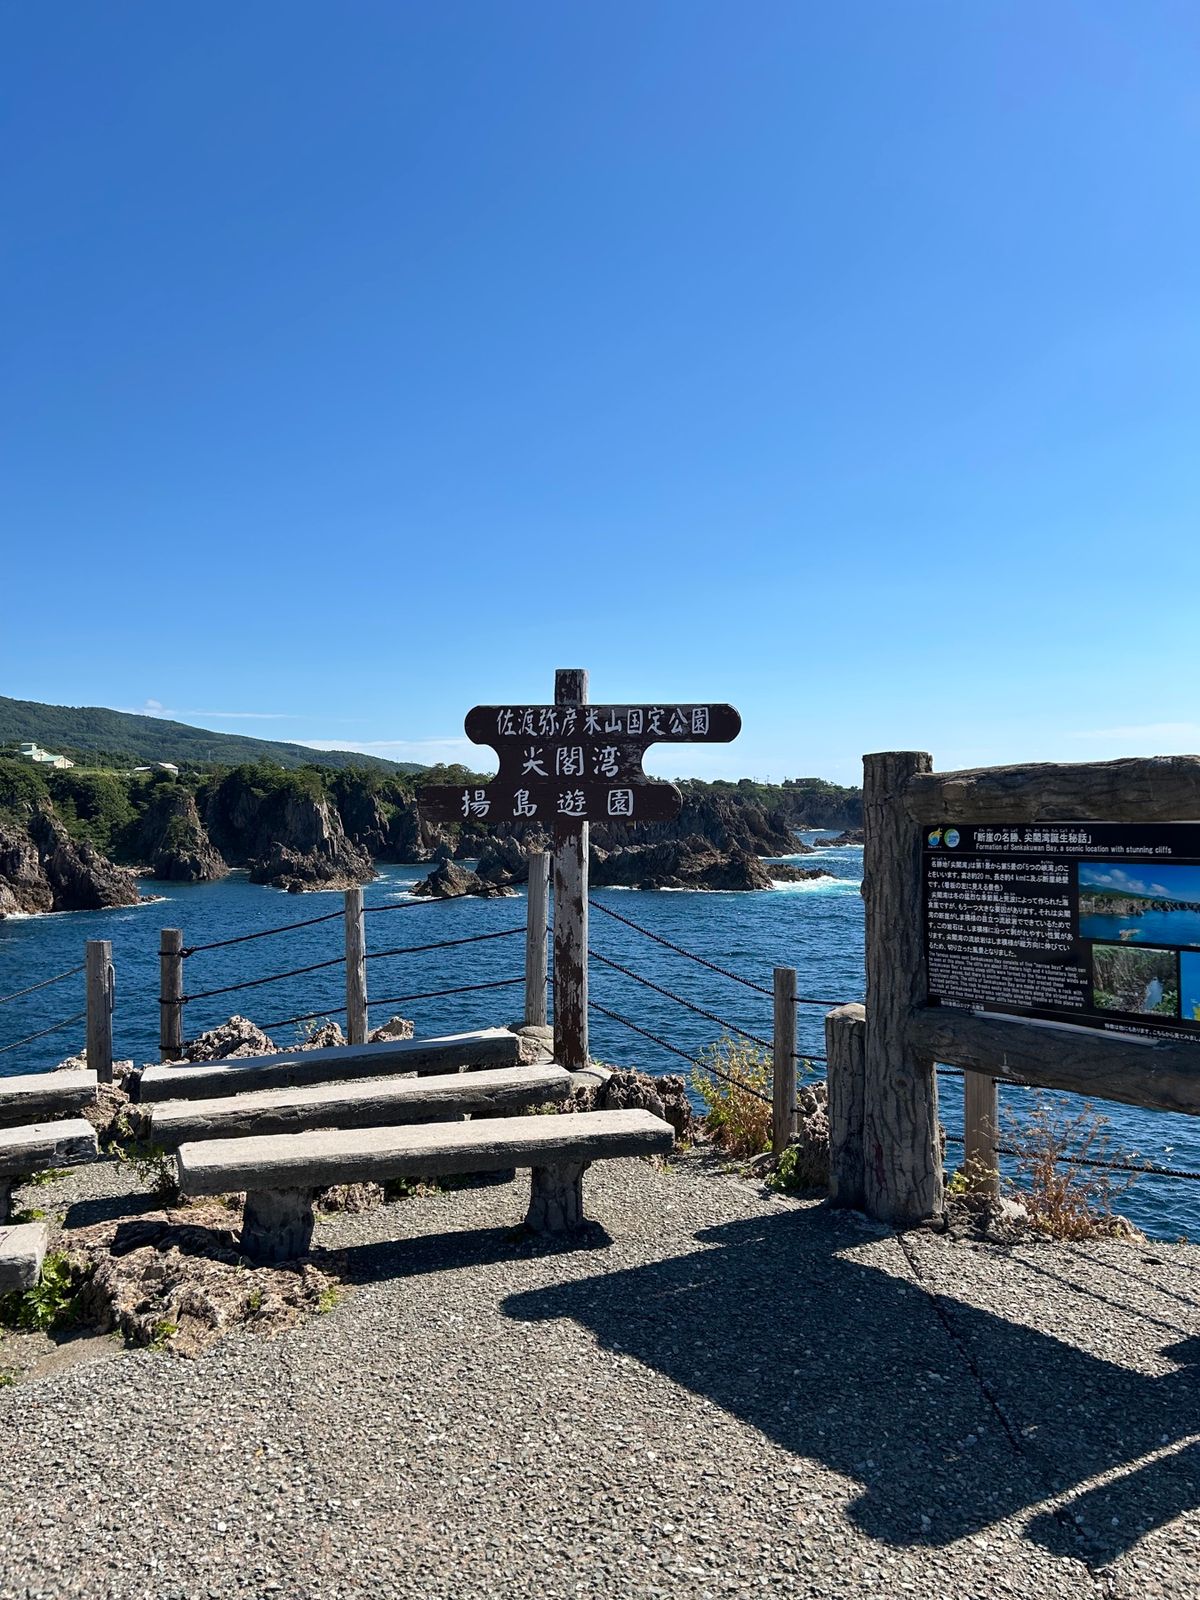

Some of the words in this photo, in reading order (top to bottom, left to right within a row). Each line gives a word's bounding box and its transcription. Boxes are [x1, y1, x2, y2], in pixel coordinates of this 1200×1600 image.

[497, 706, 710, 736] 佐渡弥彦米山国定公園
[521, 746, 621, 777] 尖閣湾
[461, 788, 635, 817] 揚島遊園
[1126, 846, 1152, 854] stunning
